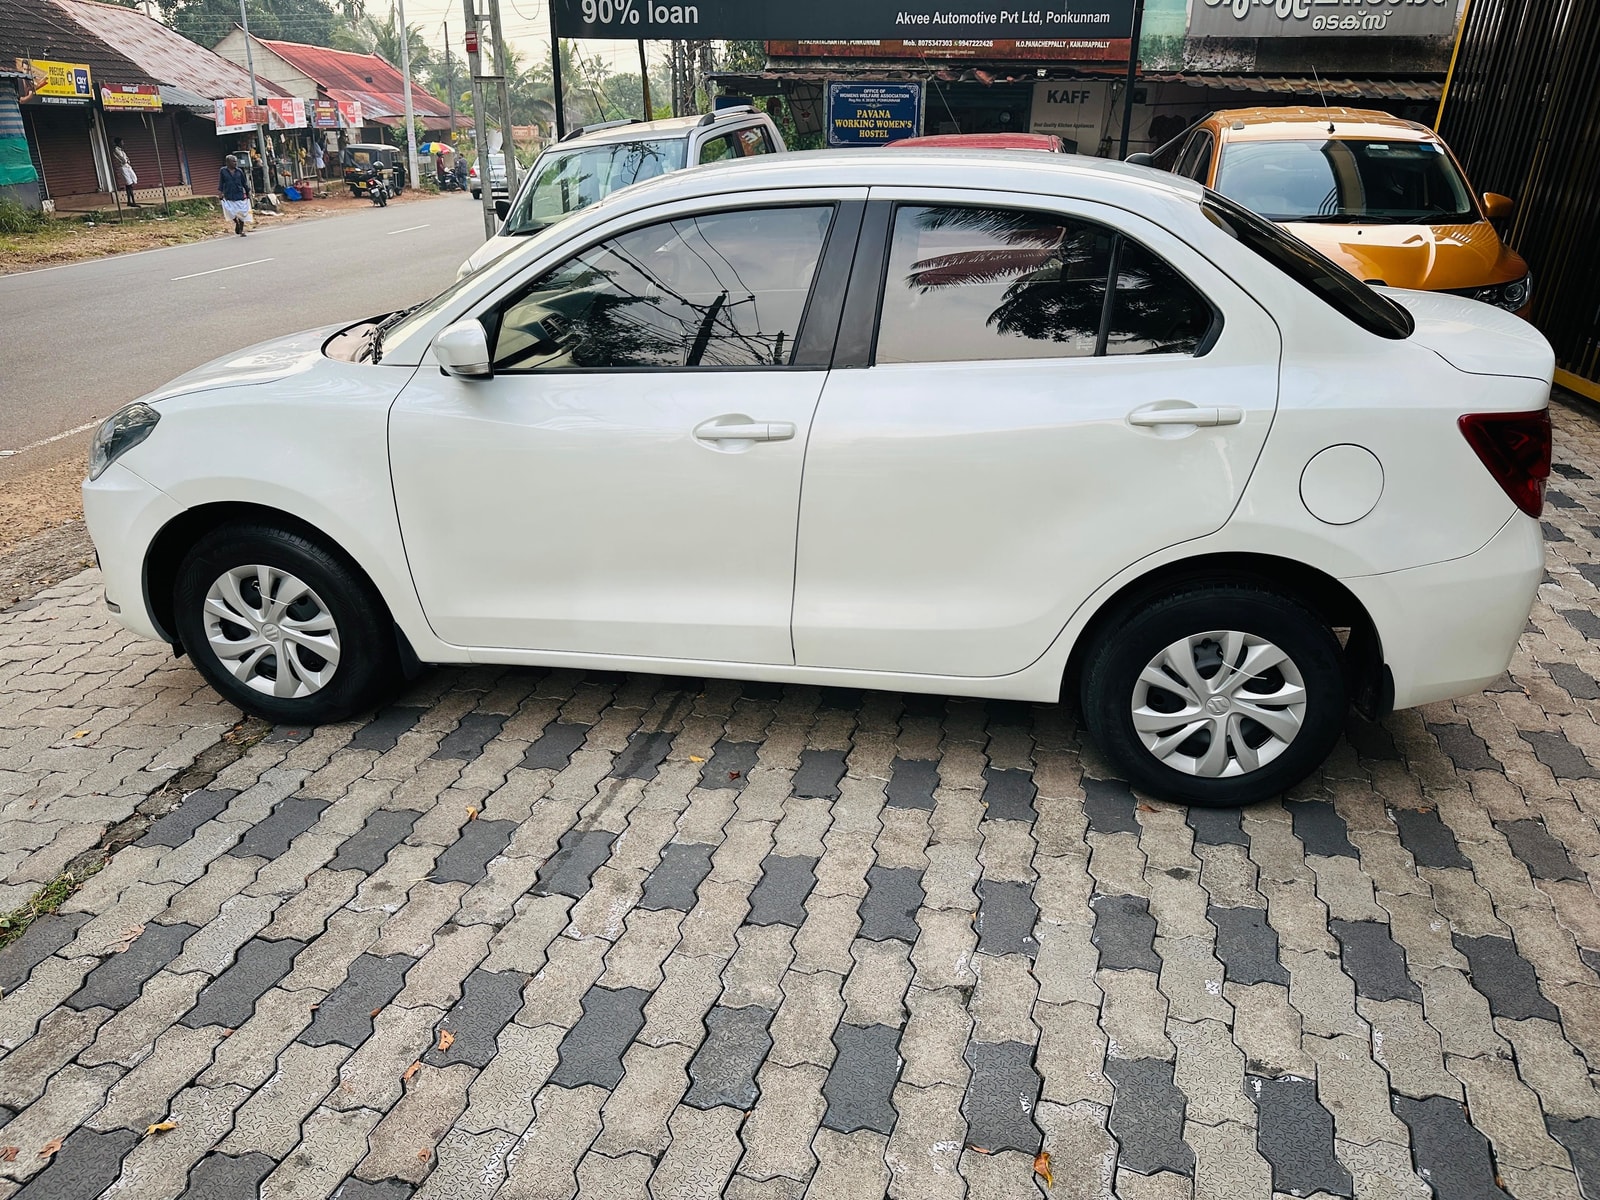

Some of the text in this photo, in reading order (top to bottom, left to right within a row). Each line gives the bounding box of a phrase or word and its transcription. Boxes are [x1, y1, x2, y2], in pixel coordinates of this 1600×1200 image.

[581, 0, 699, 24] 90% loan
[895, 11, 1110, 26] Akvee Automotive Pvt Ltd, Ponkunnam
[902, 39, 917, 47] Mob.
[1047, 90, 1090, 103] KAFF
[856, 110, 891, 118] PAVANA
[835, 119, 913, 129] WORKING WOMEN'S
[859, 129, 889, 138] HOSTEL
